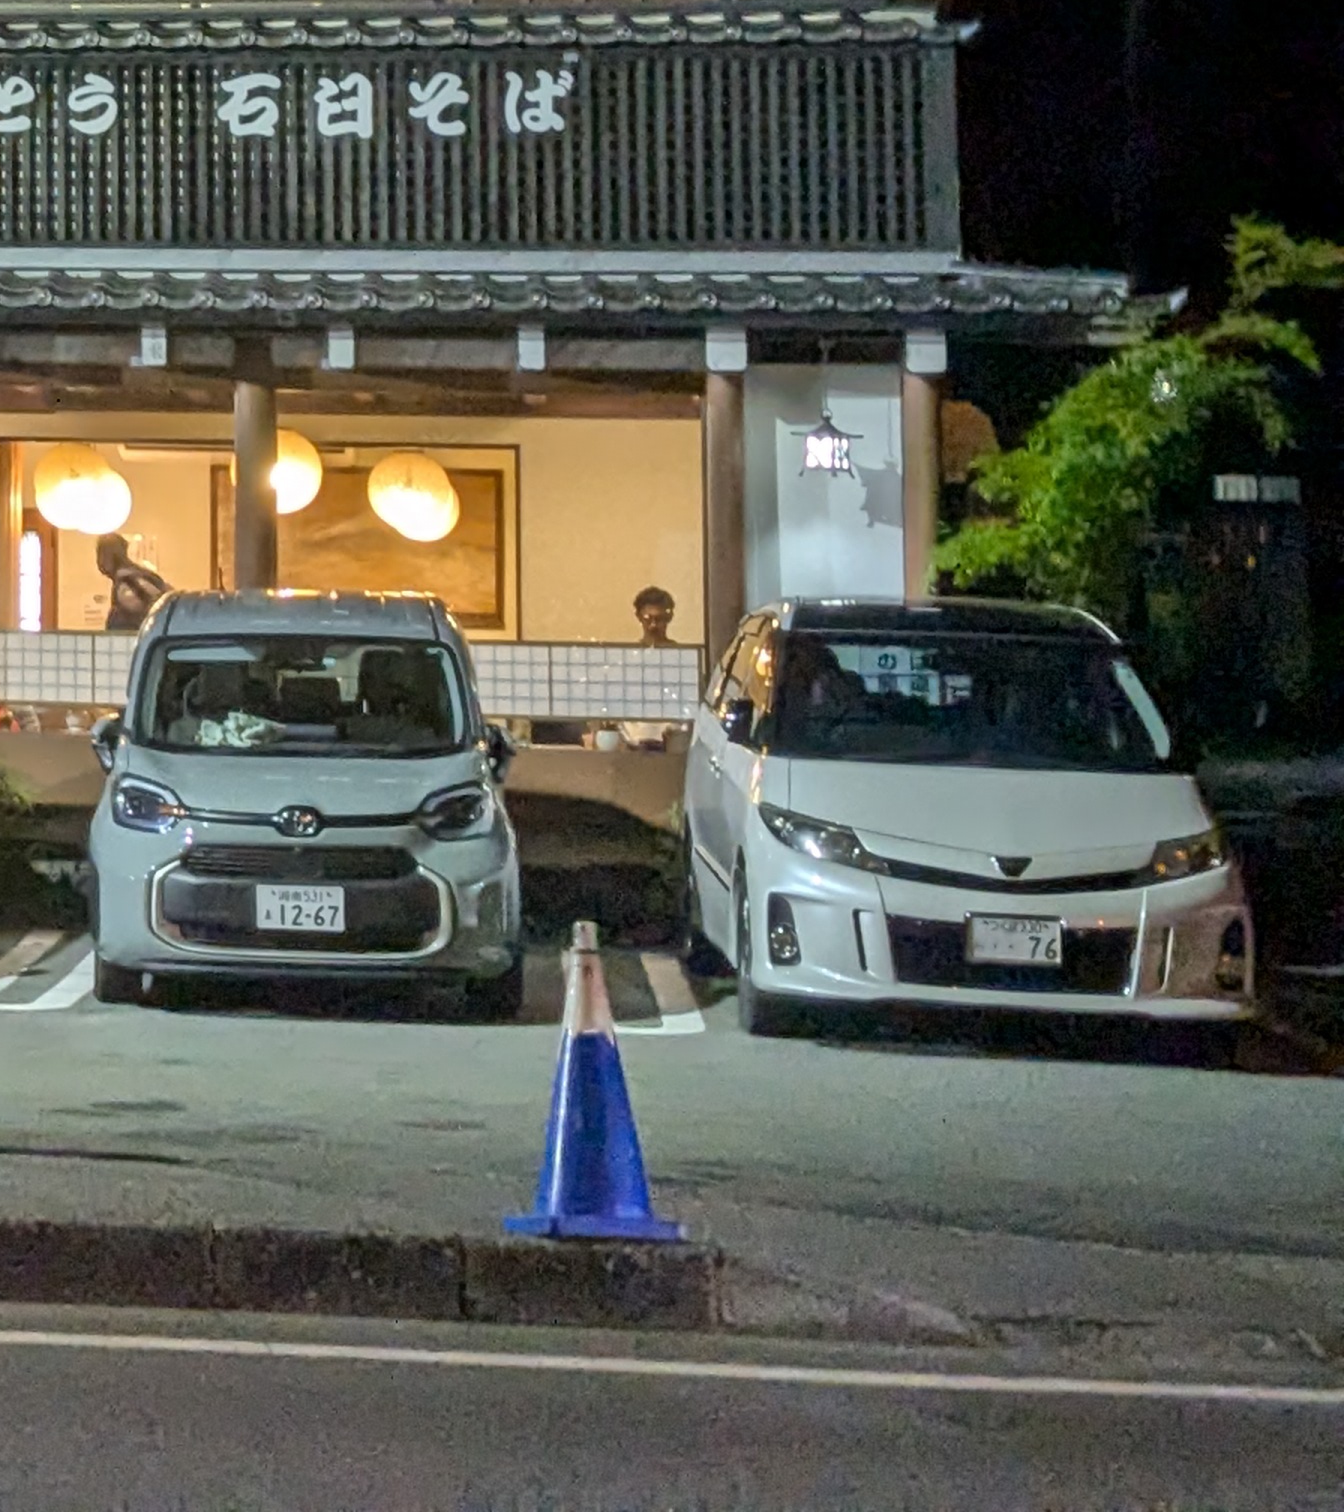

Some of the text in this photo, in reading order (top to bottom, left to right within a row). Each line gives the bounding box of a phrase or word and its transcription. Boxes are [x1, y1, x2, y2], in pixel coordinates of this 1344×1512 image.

[216, 68, 575, 138] 石臼そば
[280, 904, 339, 926] 12-67
[1028, 935, 1057, 959] 76
